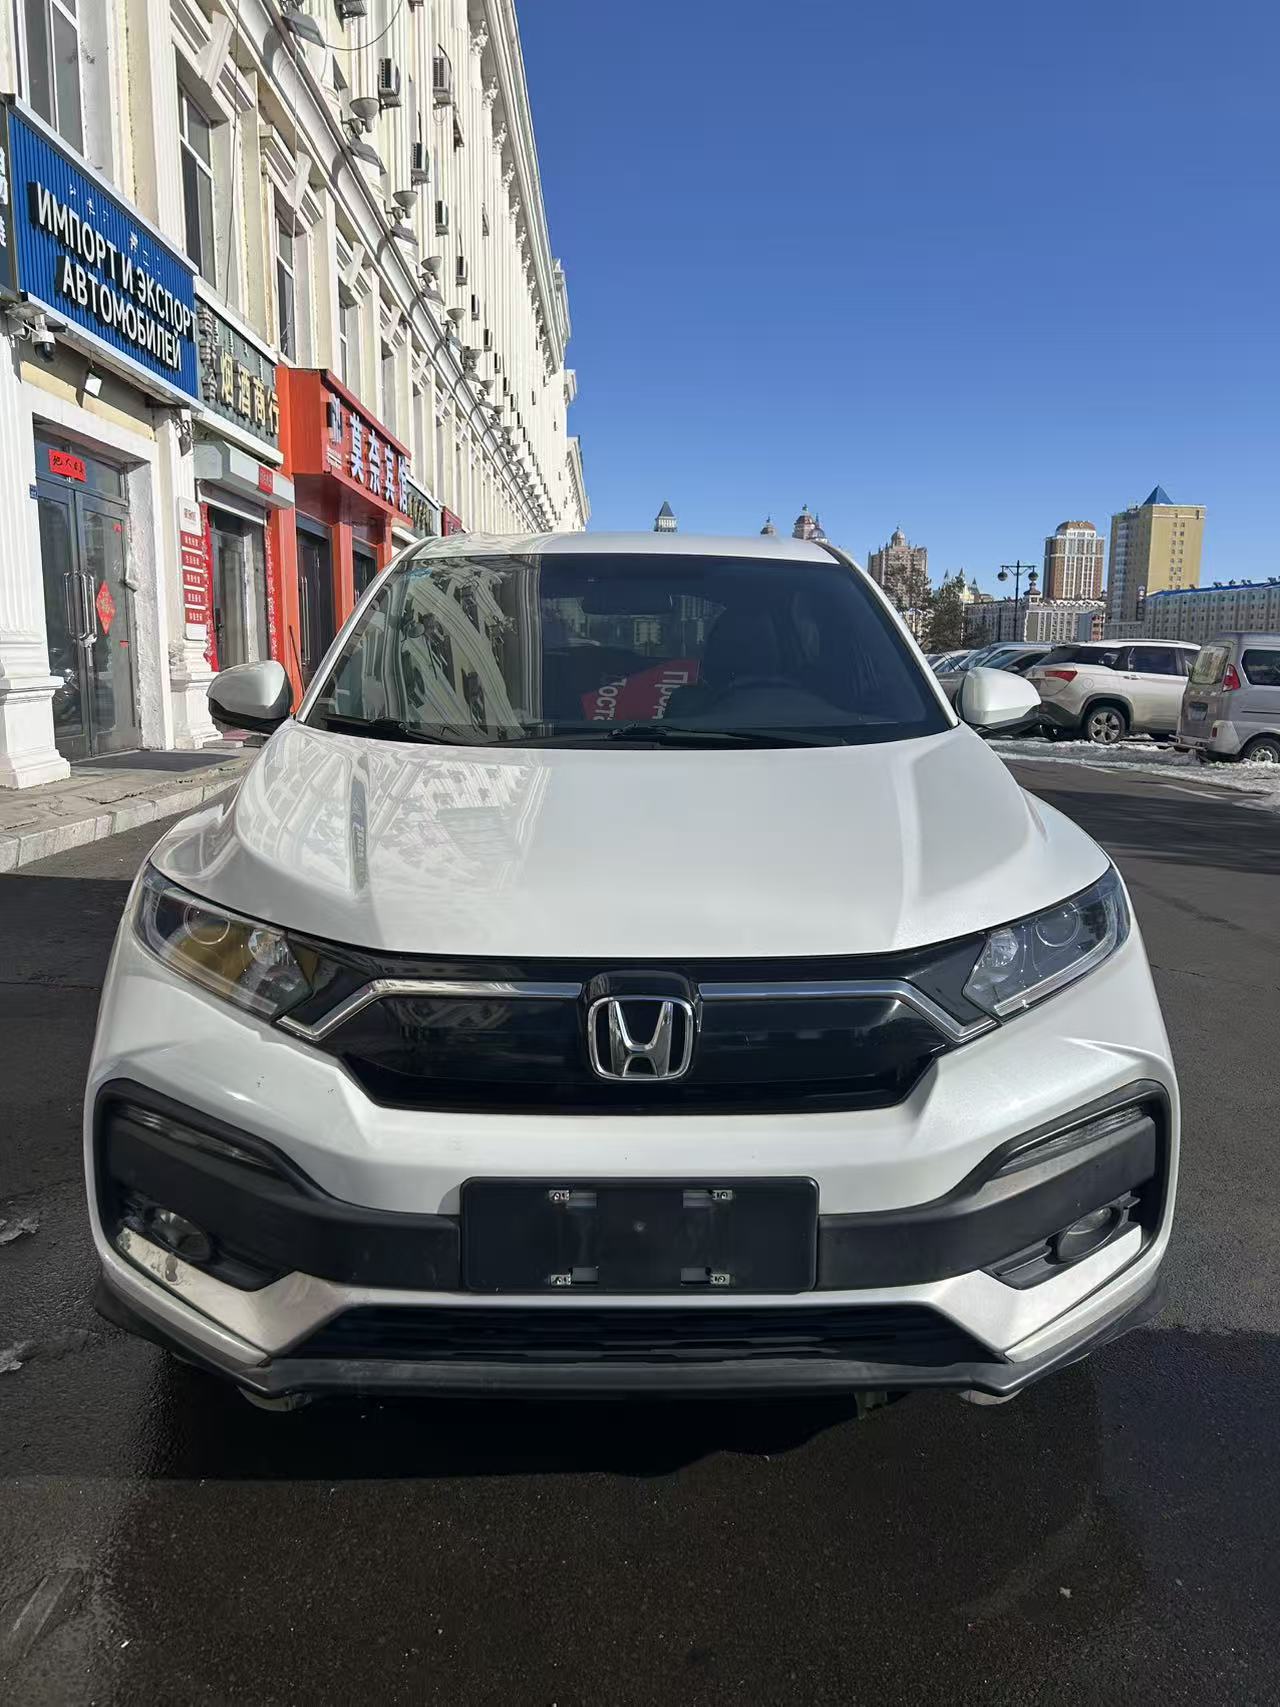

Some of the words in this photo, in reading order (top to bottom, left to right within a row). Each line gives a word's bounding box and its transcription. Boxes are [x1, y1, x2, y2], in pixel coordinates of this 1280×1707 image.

[37, 181, 116, 280] ИМПОРТ
[121, 252, 134, 295] И
[137, 266, 197, 343] ЭКСПОРТ
[62, 255, 181, 372] АВТОМОБИЛЕЙ
